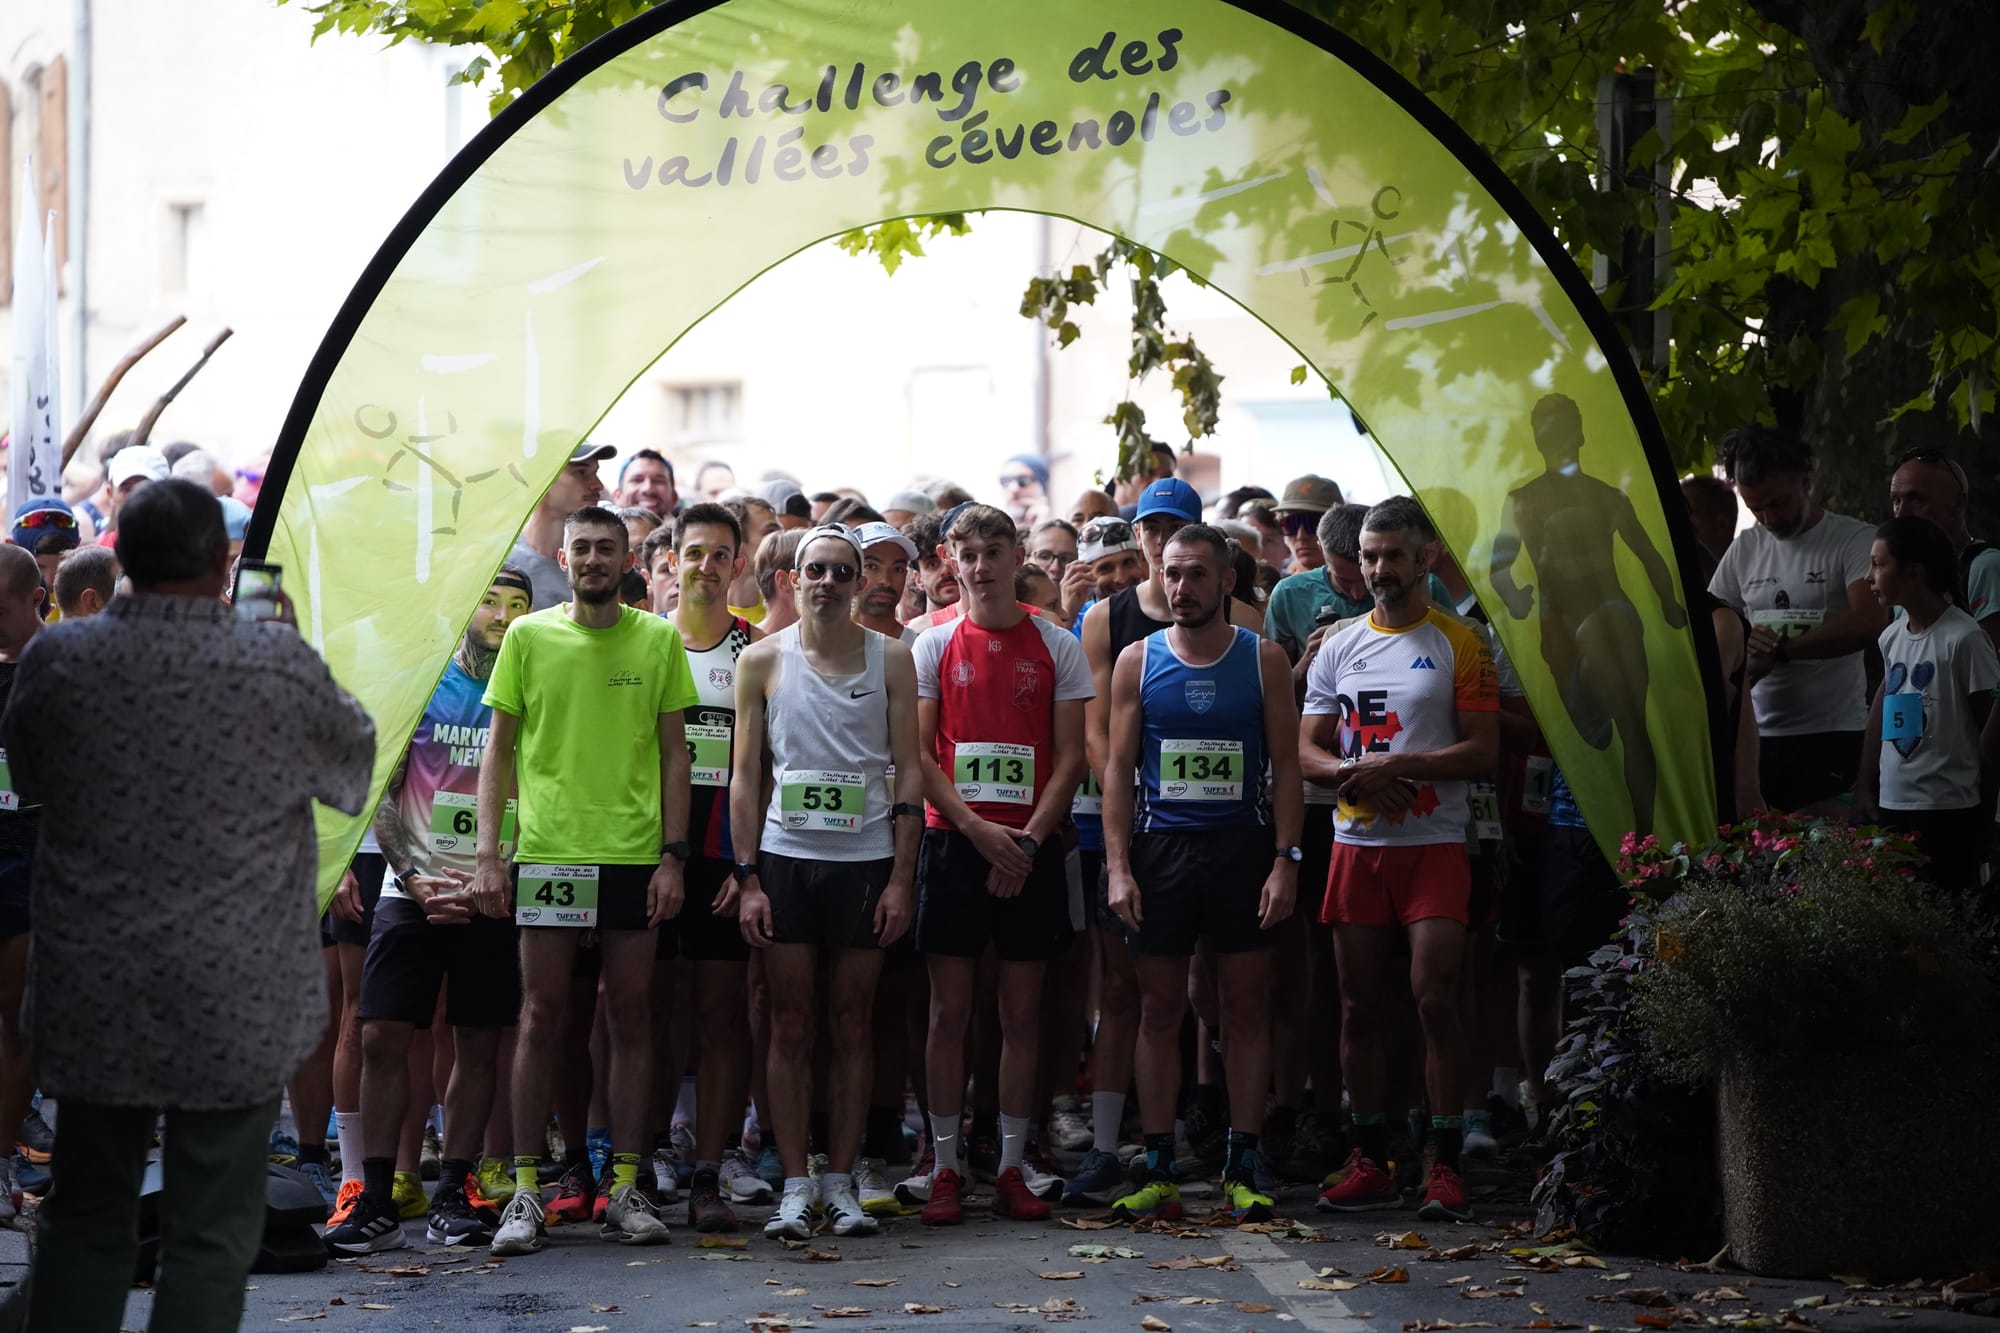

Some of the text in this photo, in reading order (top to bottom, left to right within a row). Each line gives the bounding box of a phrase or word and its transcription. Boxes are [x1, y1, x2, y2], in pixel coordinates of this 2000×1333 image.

[657, 28, 1183, 123] Challenge des
[623, 90, 1232, 190] vallées cévenoles
[1893, 711, 1904, 729] 5
[966, 757, 1024, 783] 113
[1172, 755, 1232, 780] 134
[802, 786, 843, 811] 53
[453, 810, 478, 835] 6
[535, 881, 575, 906] 43
